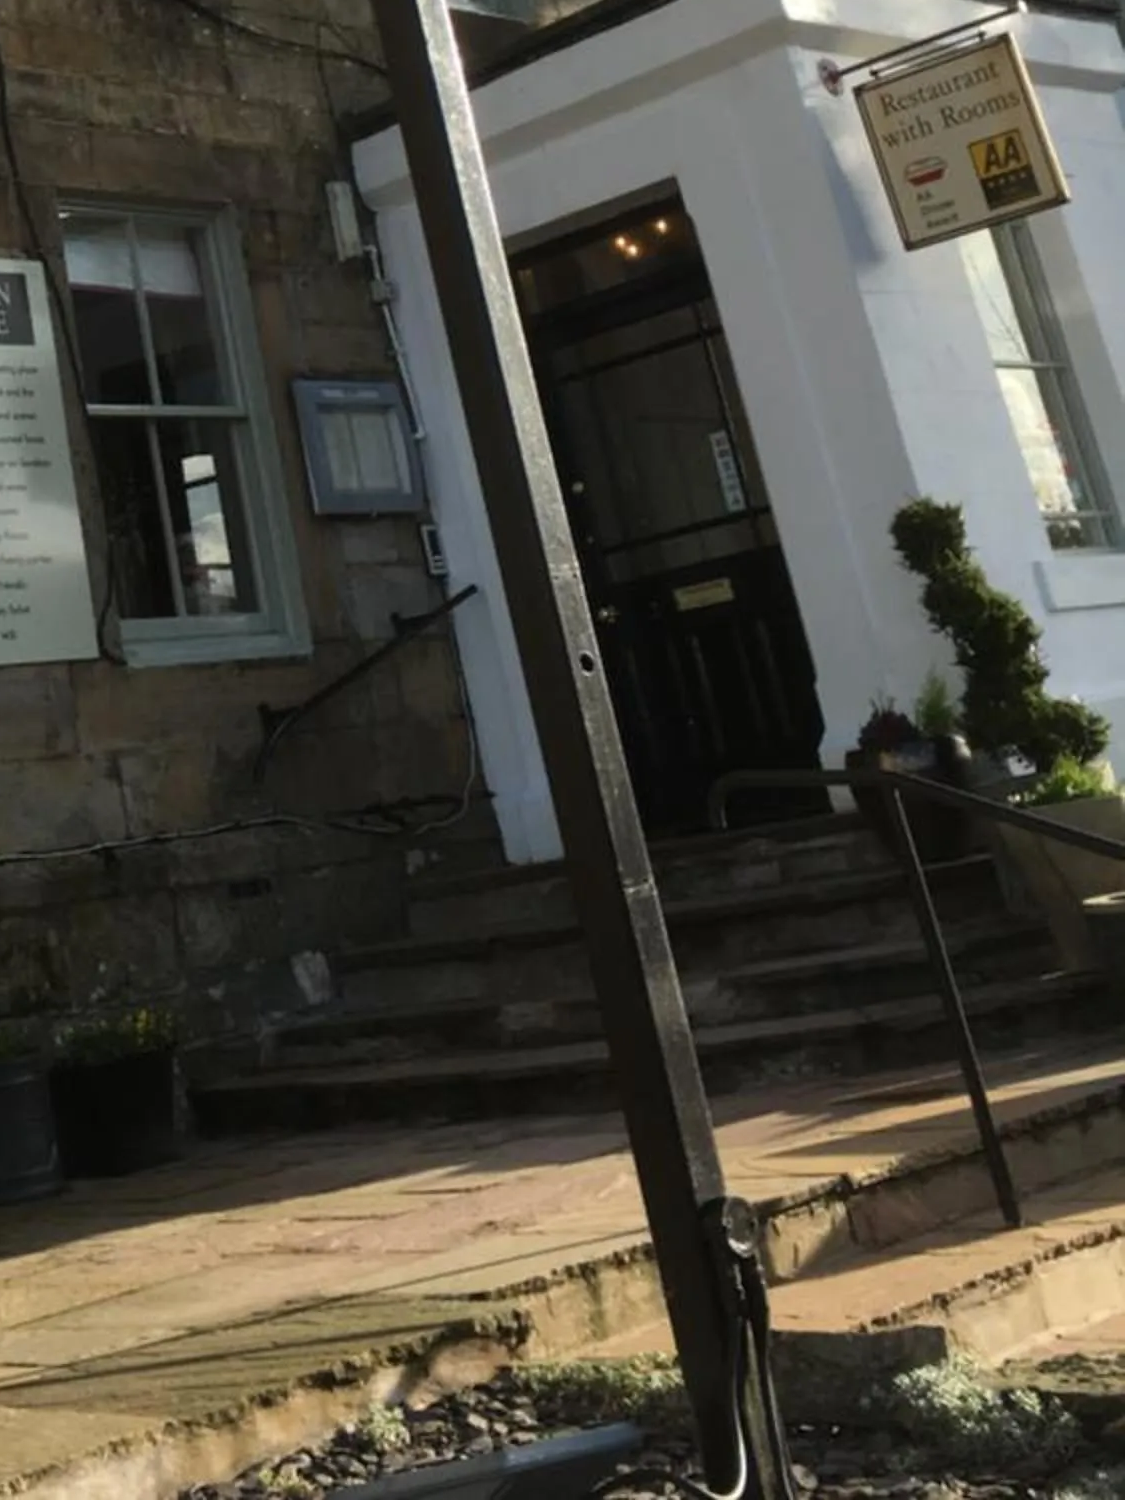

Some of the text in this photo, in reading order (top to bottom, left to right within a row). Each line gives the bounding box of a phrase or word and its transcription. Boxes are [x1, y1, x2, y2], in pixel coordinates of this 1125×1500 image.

[879, 62, 1000, 116] Restaurant
[882, 90, 1020, 149] with Rooms
[984, 135, 1022, 174] AA
